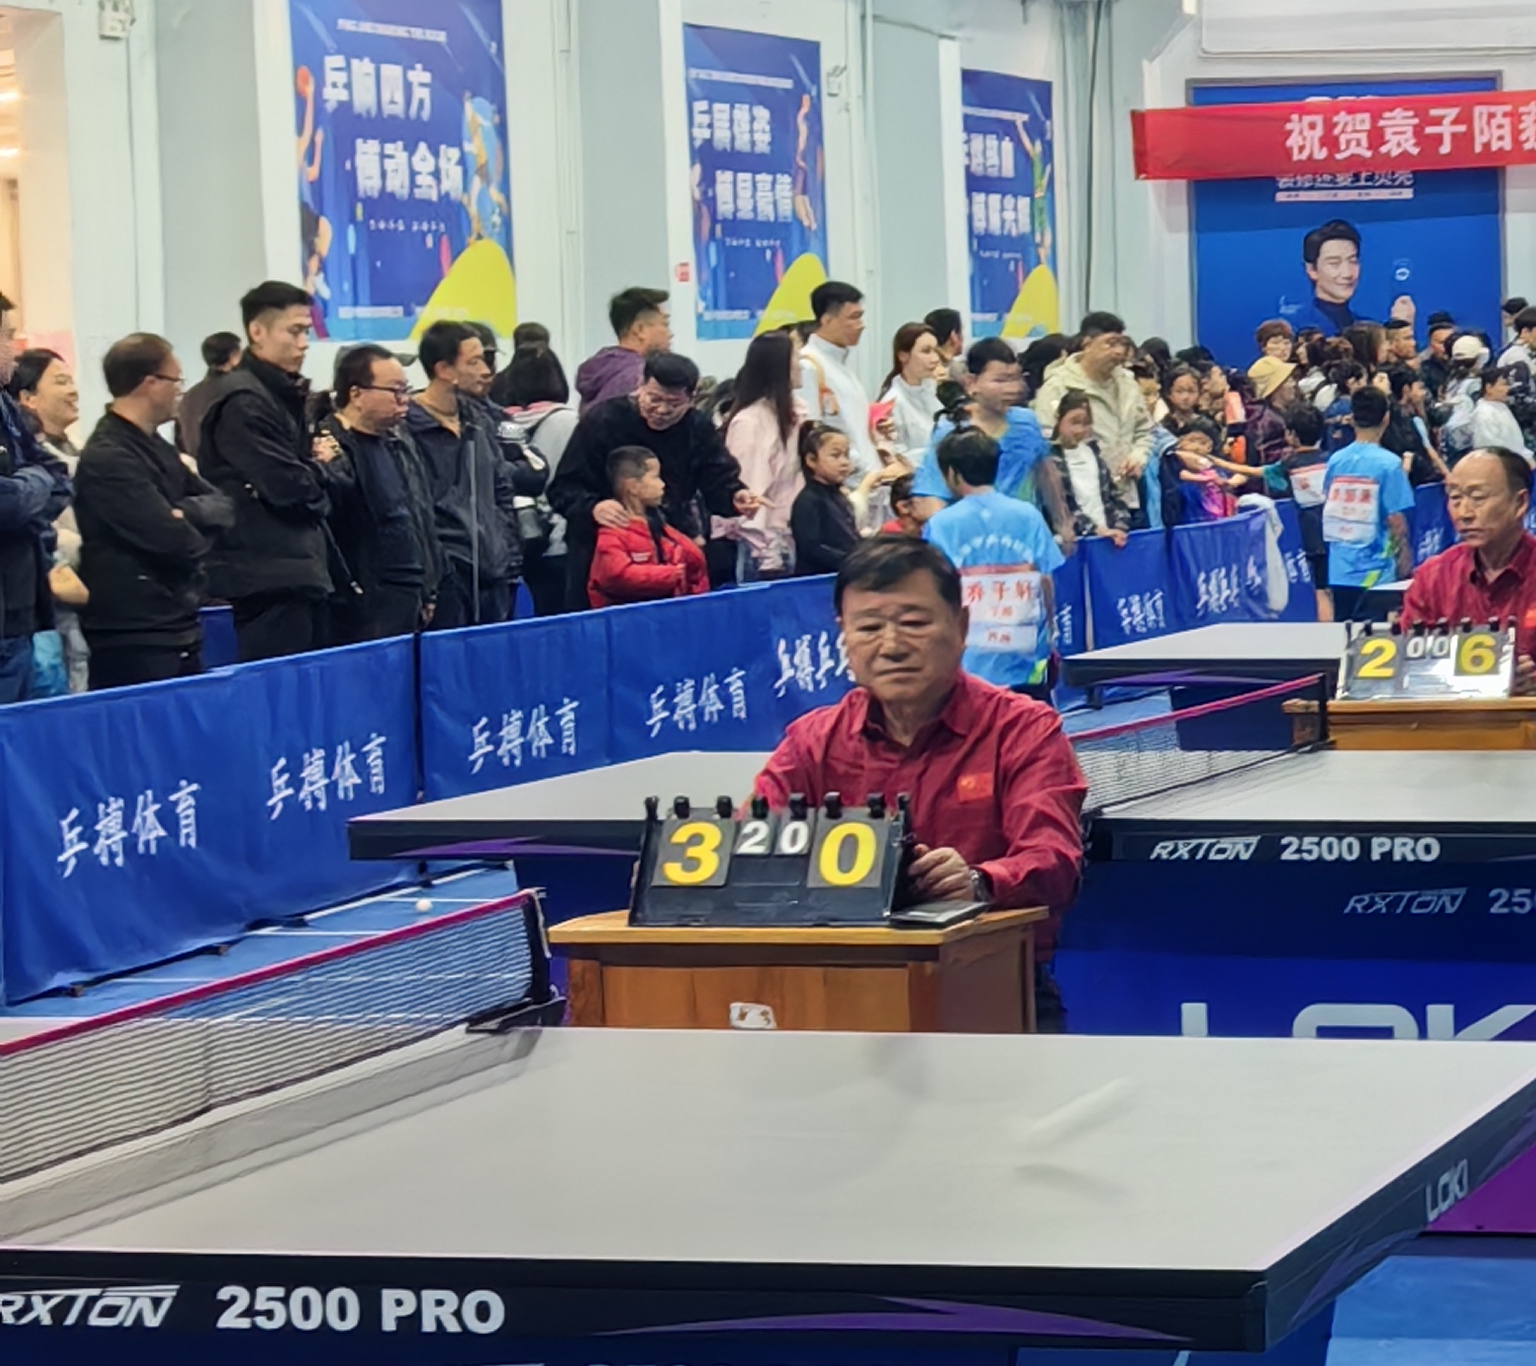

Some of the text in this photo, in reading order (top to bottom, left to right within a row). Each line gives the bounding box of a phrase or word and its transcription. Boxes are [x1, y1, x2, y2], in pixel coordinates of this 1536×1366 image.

[1357, 638, 1397, 677] 2
[1460, 634, 1497, 674] 6
[662, 821, 877, 885] 3 2 0 0
[1149, 836, 1441, 862] RXTON 2500 PRO
[1343, 887, 1467, 913] RXTON
[1426, 1159, 1469, 1222] LOKI
[216, 1285, 361, 1331] 2500
[380, 1287, 506, 1334] PRO
